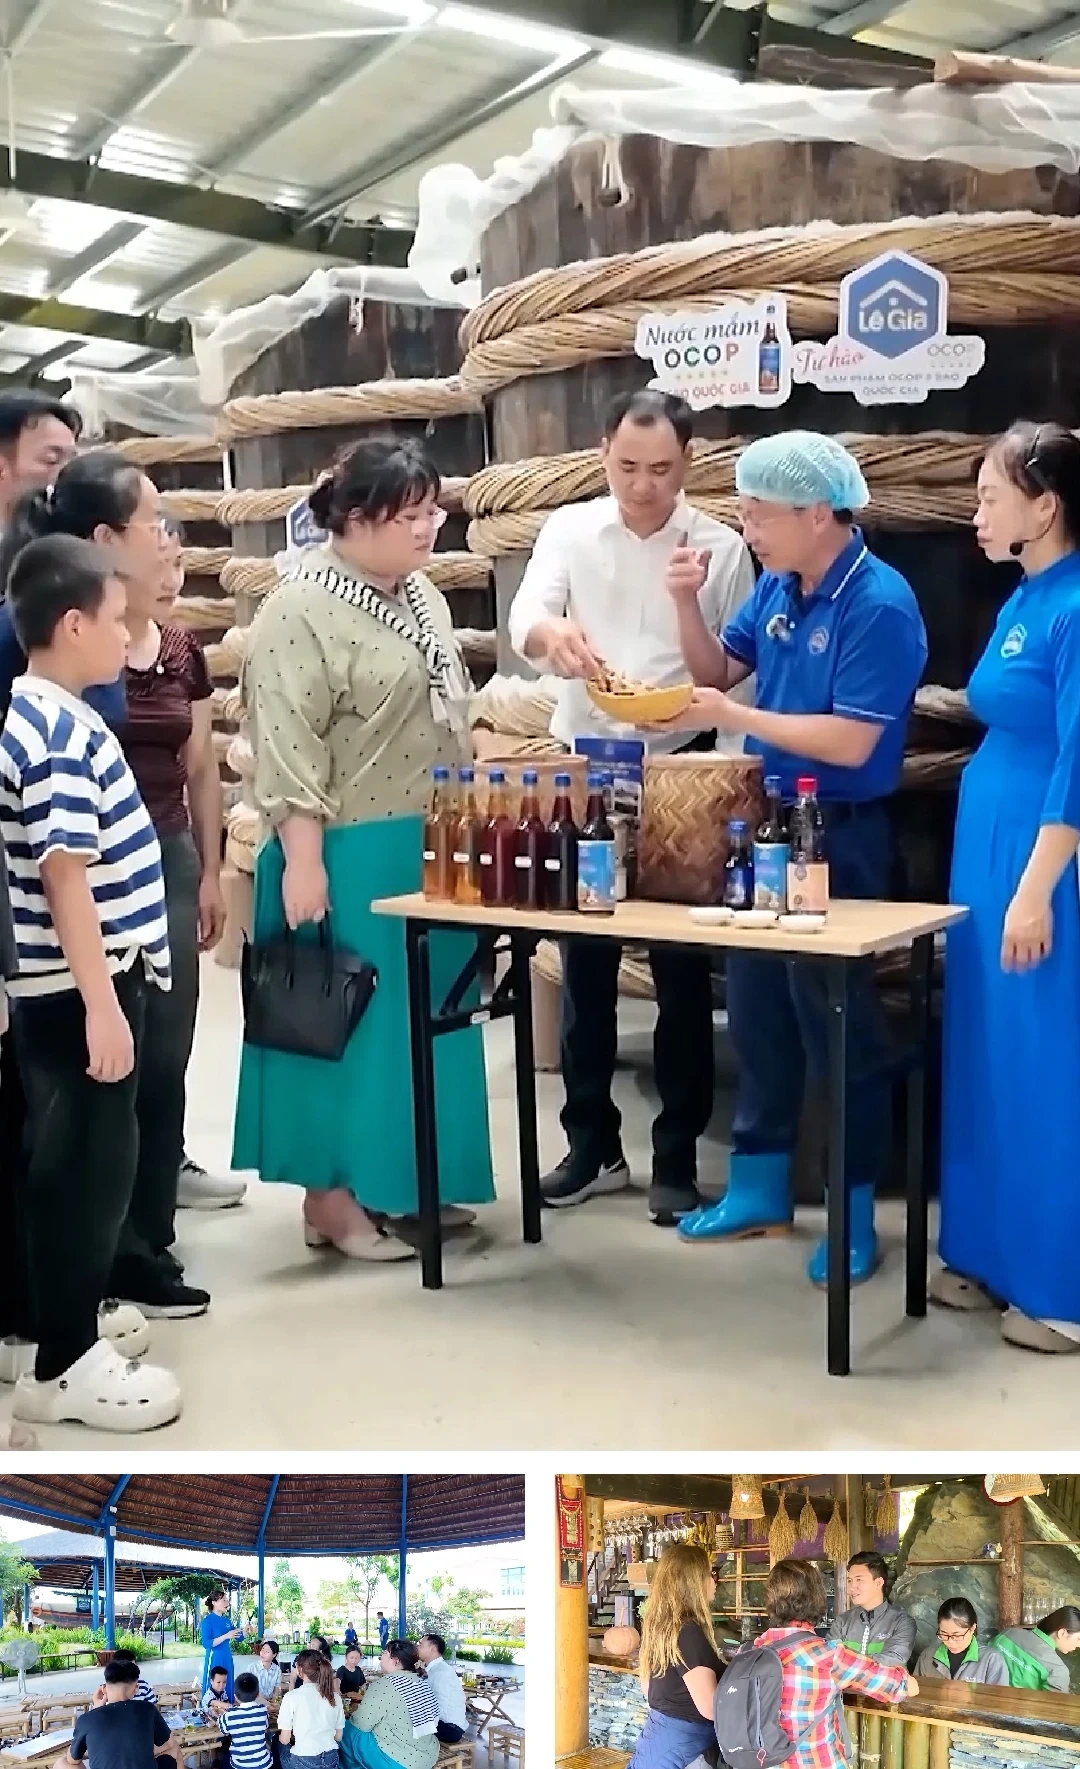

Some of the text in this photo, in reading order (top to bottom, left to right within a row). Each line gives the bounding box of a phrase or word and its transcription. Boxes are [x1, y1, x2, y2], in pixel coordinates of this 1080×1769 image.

[887, 308, 928, 331] Gia
[664, 343, 739, 369] OCOP
[927, 343, 976, 357] OCOP
